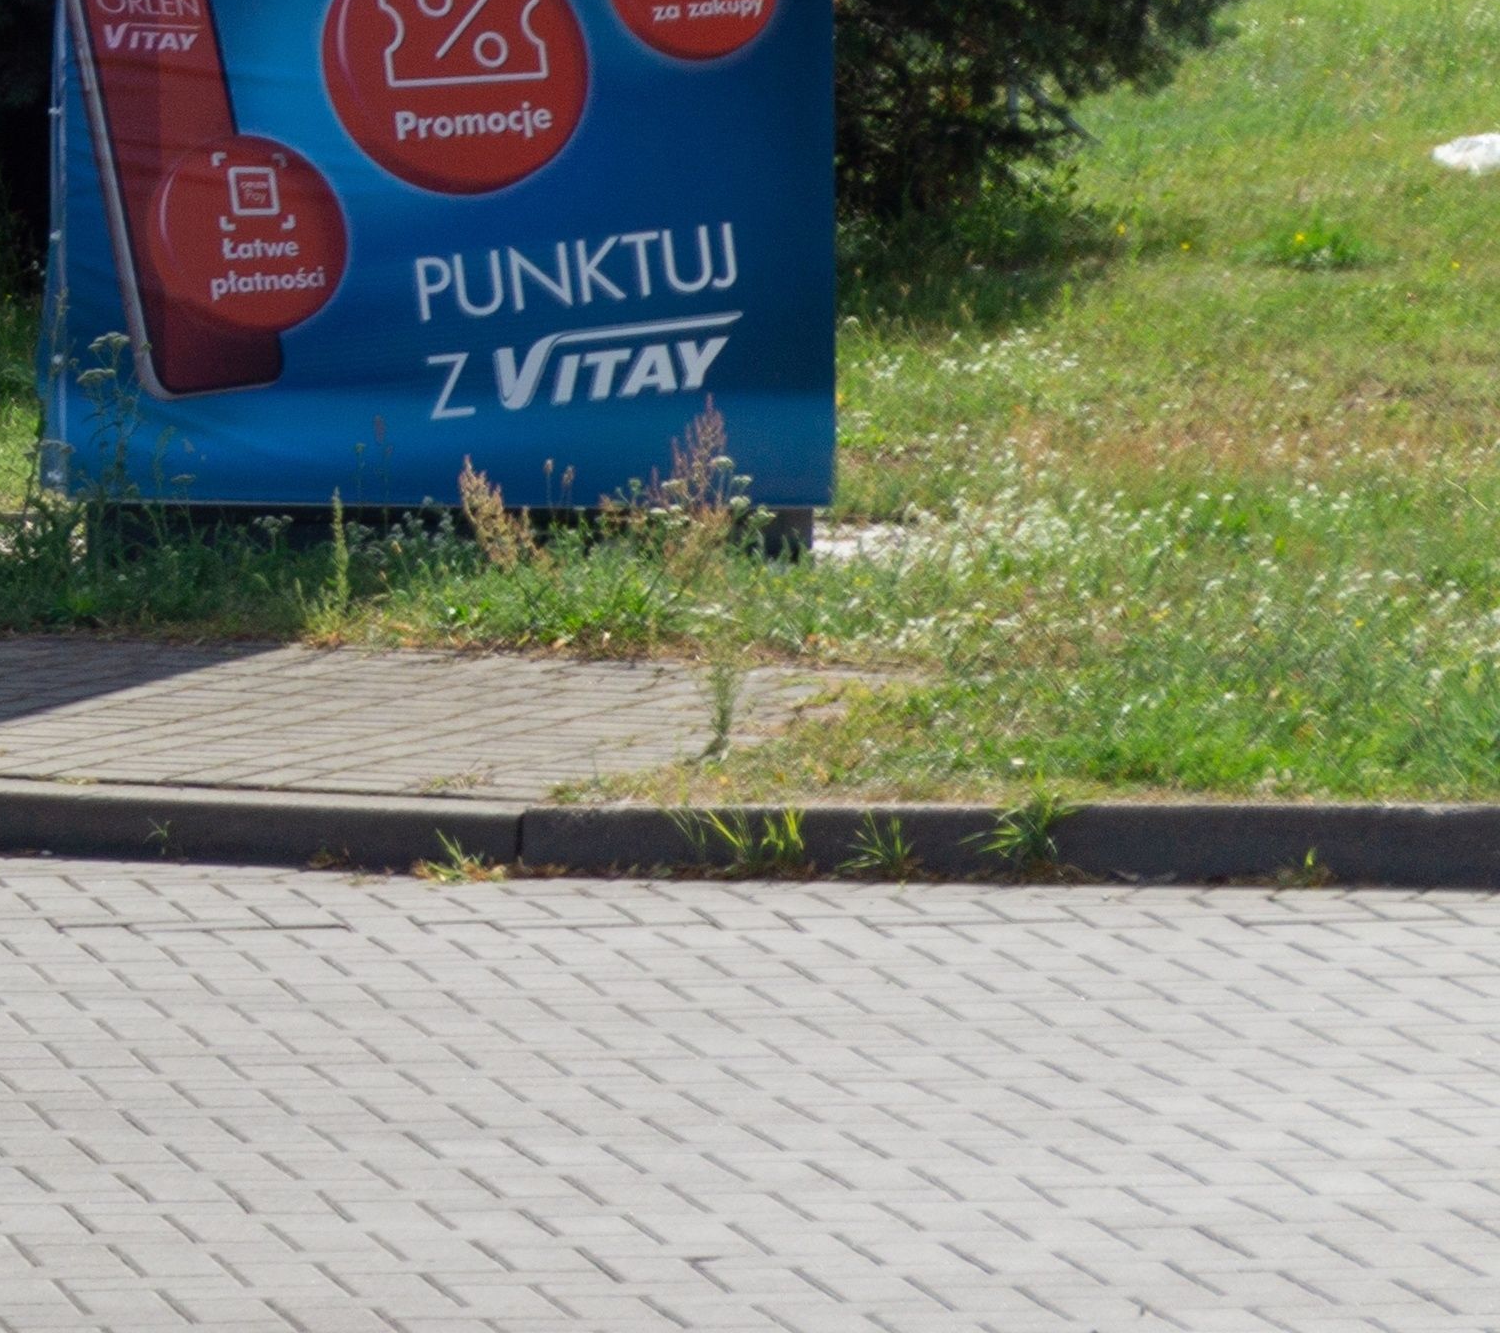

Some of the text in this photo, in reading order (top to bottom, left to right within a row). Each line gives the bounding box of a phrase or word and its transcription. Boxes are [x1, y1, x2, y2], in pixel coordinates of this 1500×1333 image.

[652, 4, 681, 23] za
[394, 100, 552, 141] Promocje
[222, 237, 300, 260] Łatwe
[210, 266, 326, 302] płatności
[414, 222, 738, 323] PUNKTUJ
